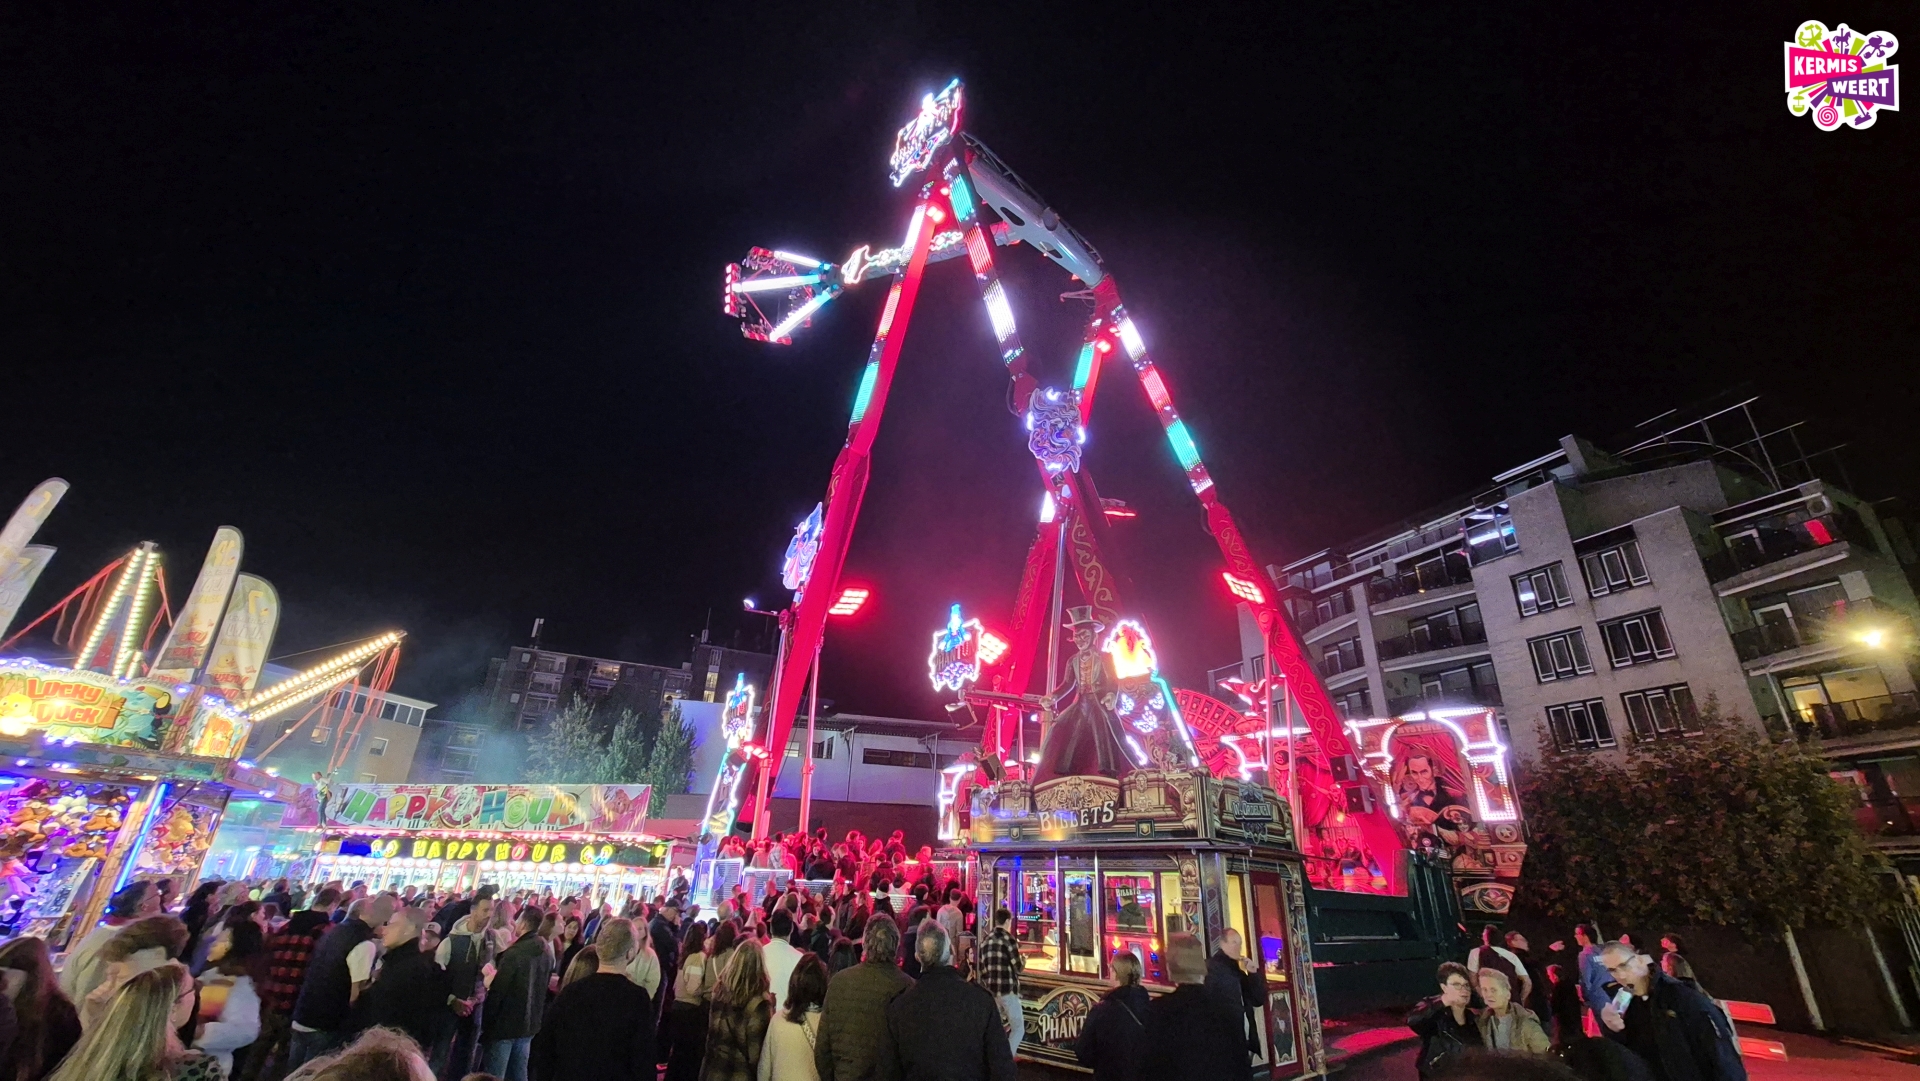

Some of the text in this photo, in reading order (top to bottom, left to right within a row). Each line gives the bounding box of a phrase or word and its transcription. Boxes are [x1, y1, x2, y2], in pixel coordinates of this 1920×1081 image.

[27, 678, 104, 703] LUCKY
[36, 702, 101, 724] DUCK
[342, 788, 574, 828] HAPPY HOUR
[1039, 800, 1115, 832] BILLETS
[413, 840, 566, 863] HAPPY HOUR
[1038, 1009, 1088, 1042] PHANT
